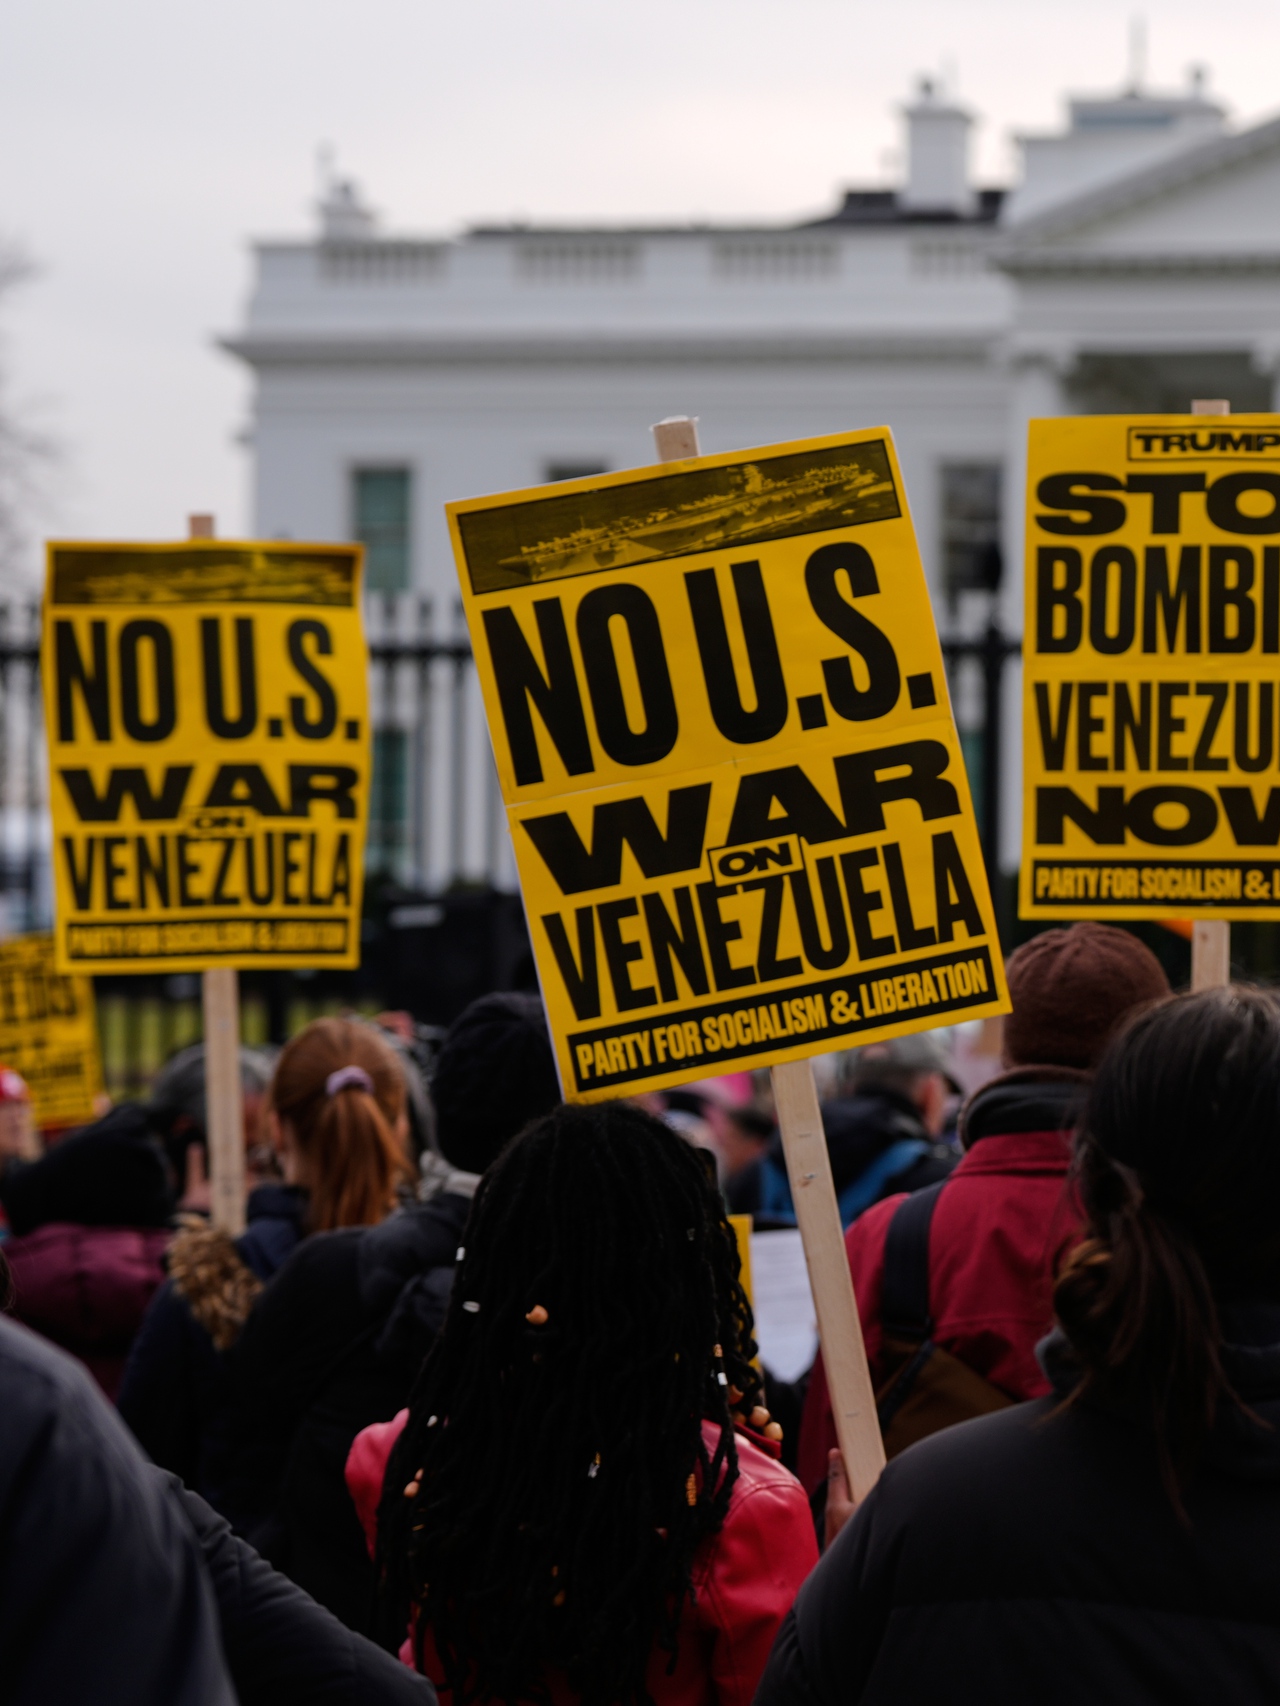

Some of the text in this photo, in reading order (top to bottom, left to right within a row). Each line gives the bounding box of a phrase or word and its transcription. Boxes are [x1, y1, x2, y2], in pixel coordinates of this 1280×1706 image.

[53, 617, 361, 743] NO U.S.
[482, 541, 938, 787] NO U.S.
[58, 763, 360, 823] WAR
[518, 739, 963, 896] WAR
[62, 830, 351, 911] VENEZUELA
[716, 842, 795, 878] ON
[1036, 867, 1099, 899] PARTY
[1100, 867, 1139, 899] FOR
[1140, 867, 1242, 900] SOCIALISM
[1243, 869, 1271, 899] &
[540, 830, 987, 1022] VENEZUELA
[575, 958, 989, 1080] PARTY FOR SOCIALISM & LIBERATION
